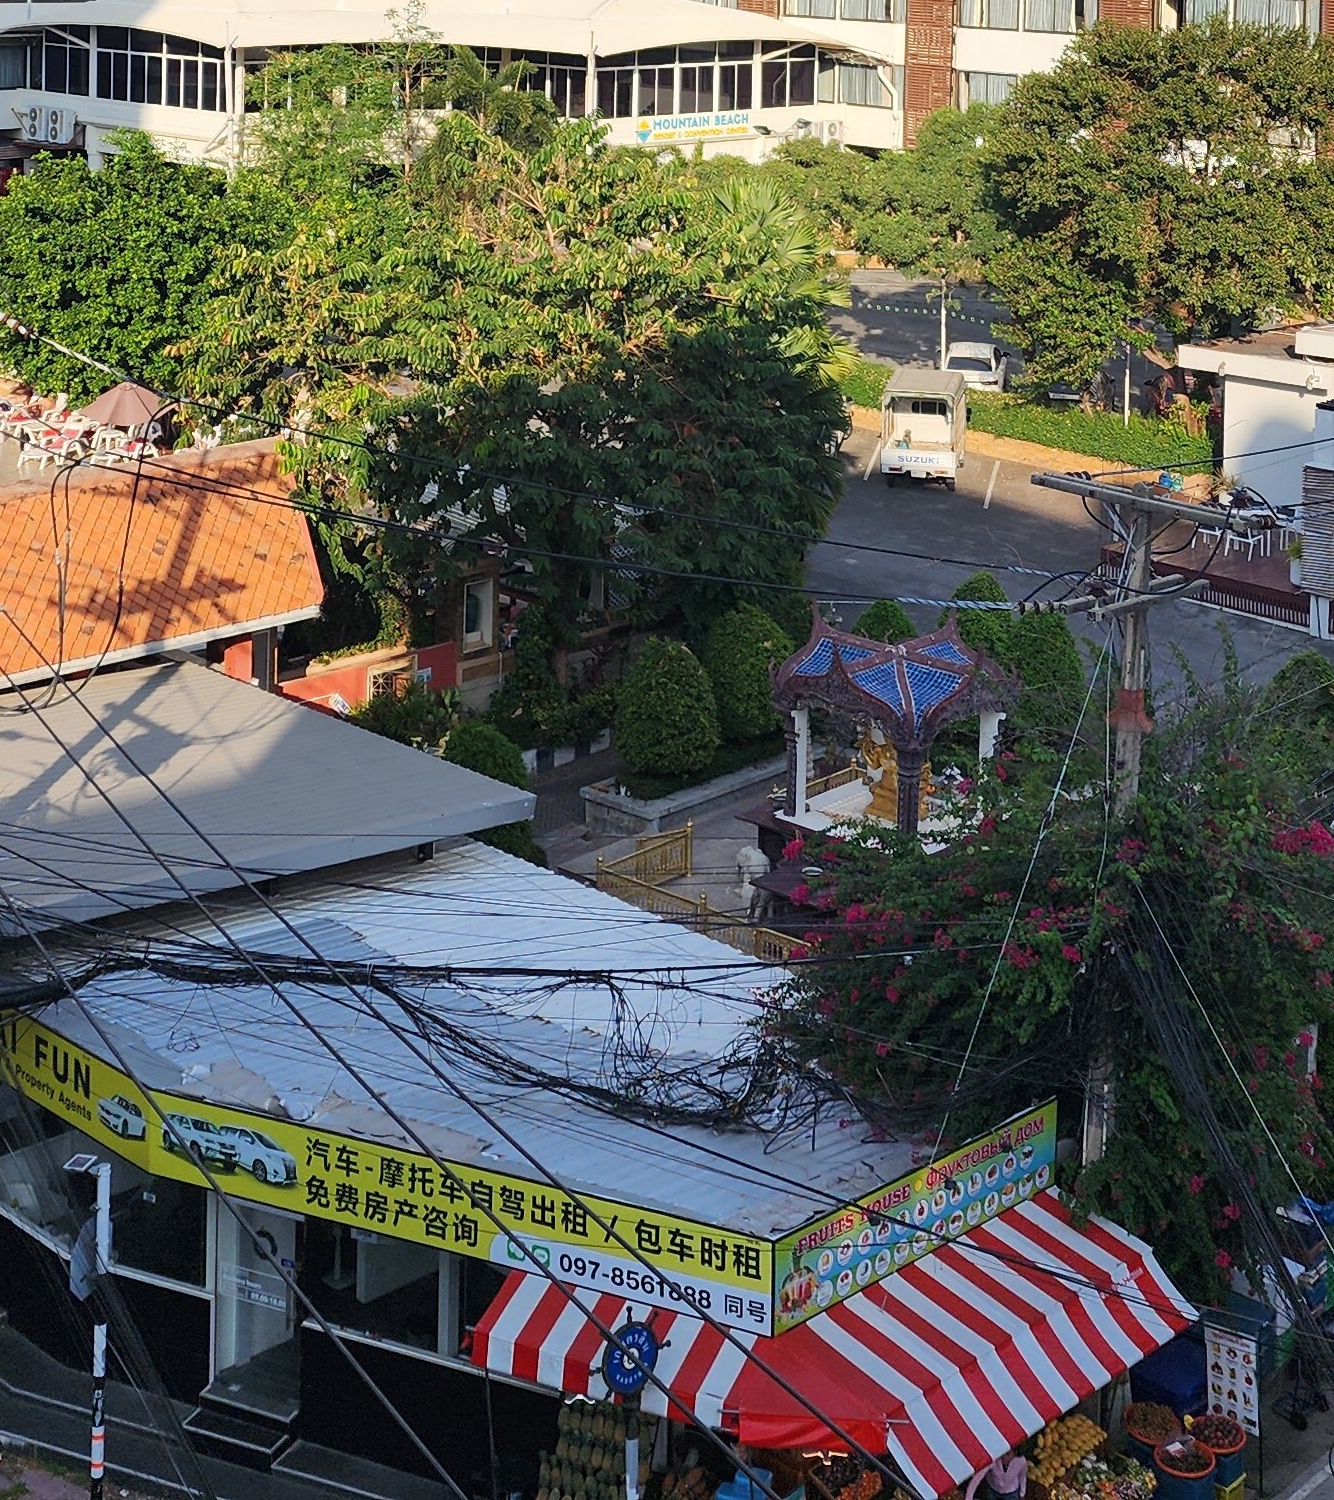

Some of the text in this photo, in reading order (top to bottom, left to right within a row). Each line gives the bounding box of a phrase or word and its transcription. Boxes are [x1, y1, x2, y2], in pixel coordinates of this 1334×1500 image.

[653, 113, 749, 130] MOUNTAIN BEACH
[897, 455, 940, 464] SUZUKI
[34, 1034, 91, 1100] FUN
[16, 1063, 92, 1122] Property Agents
[1013, 1116, 1045, 1147] ДОМ
[305, 1174, 479, 1248] 免费房产咨询
[635, 1218, 762, 1281] 包车时租
[797, 1213, 855, 1256] FRUITS
[723, 1293, 767, 1324] 同号
